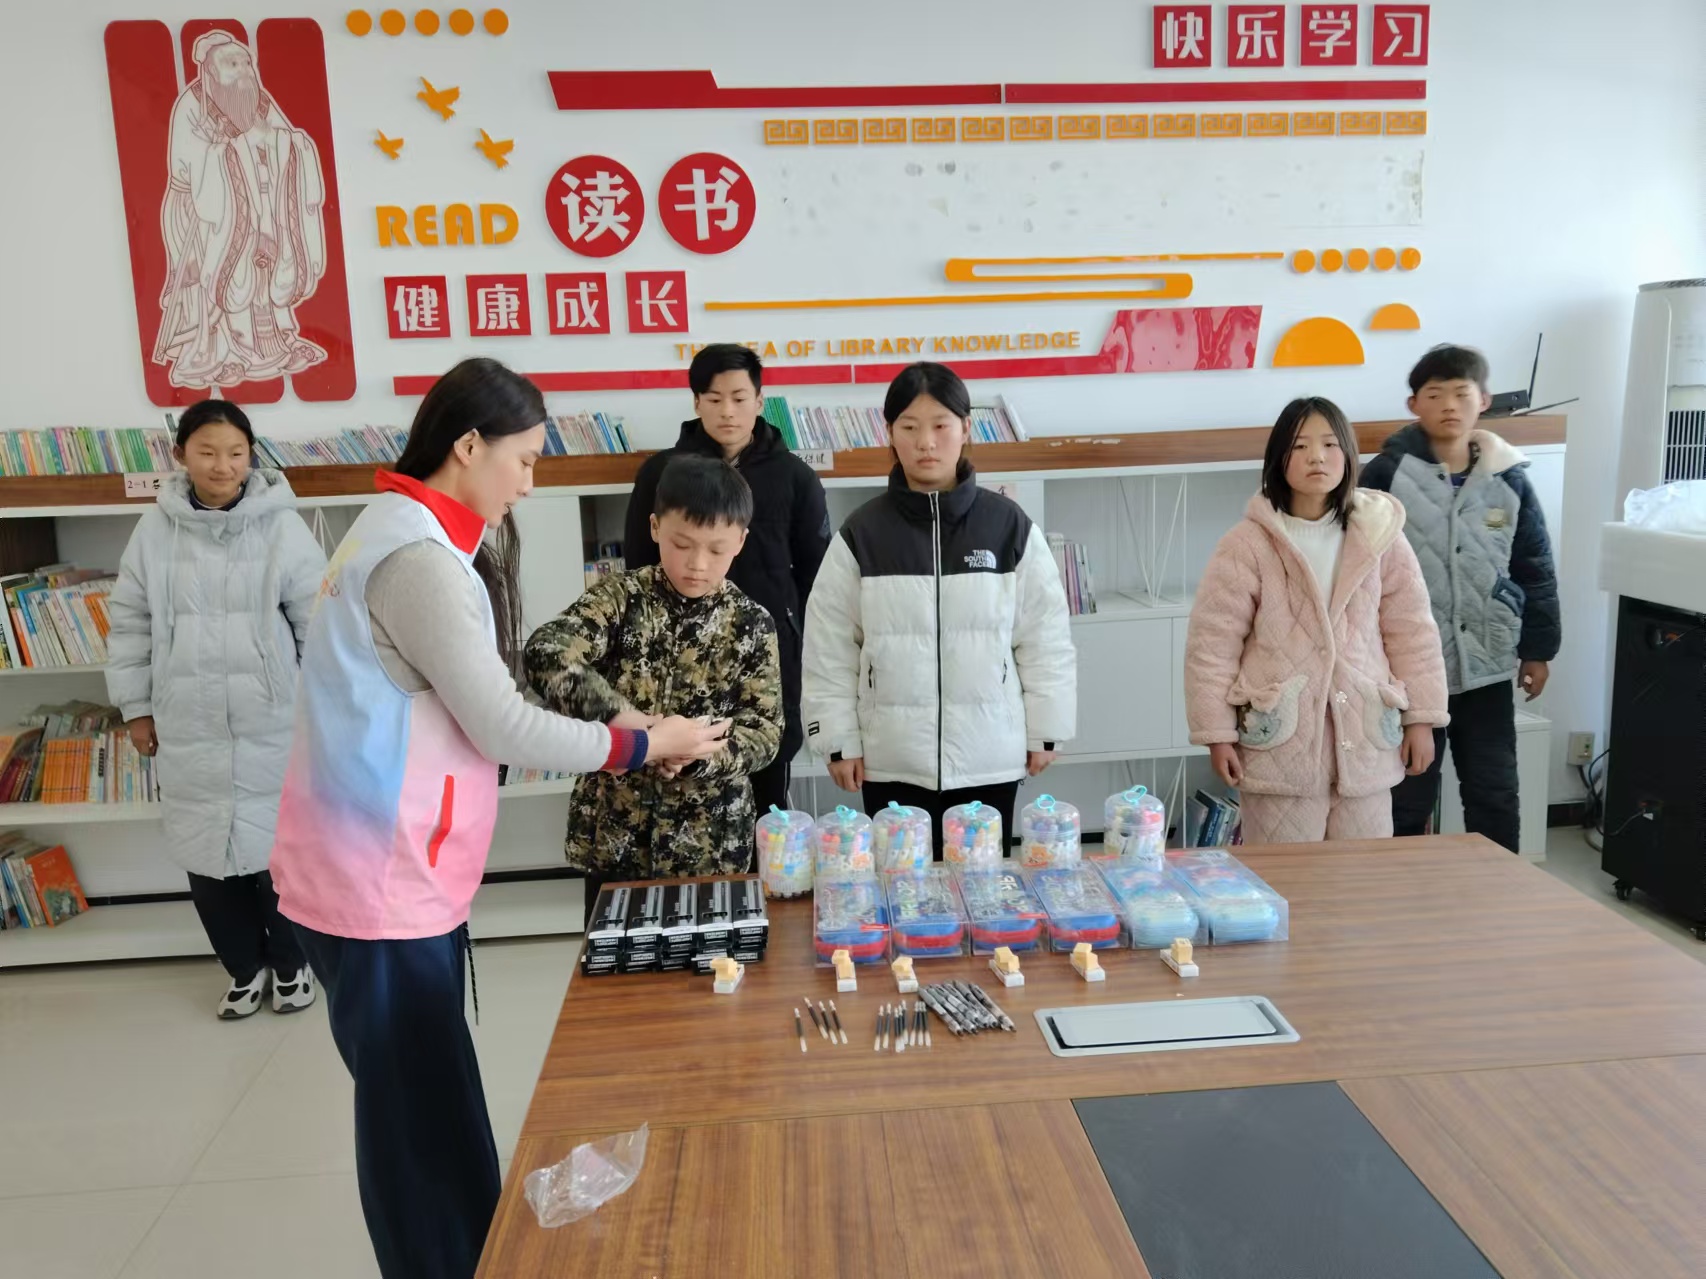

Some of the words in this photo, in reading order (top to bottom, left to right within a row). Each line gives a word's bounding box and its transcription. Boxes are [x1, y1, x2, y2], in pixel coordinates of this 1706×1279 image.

[1162, 11, 1422, 59] 快乐学习
[376, 203, 519, 247] READ
[560, 165, 740, 243] 读书
[393, 281, 678, 332] 健康成长
[786, 340, 815, 357] OF
[827, 336, 925, 356] LIBRARY
[933, 331, 1080, 353] KNOWLEDGE
